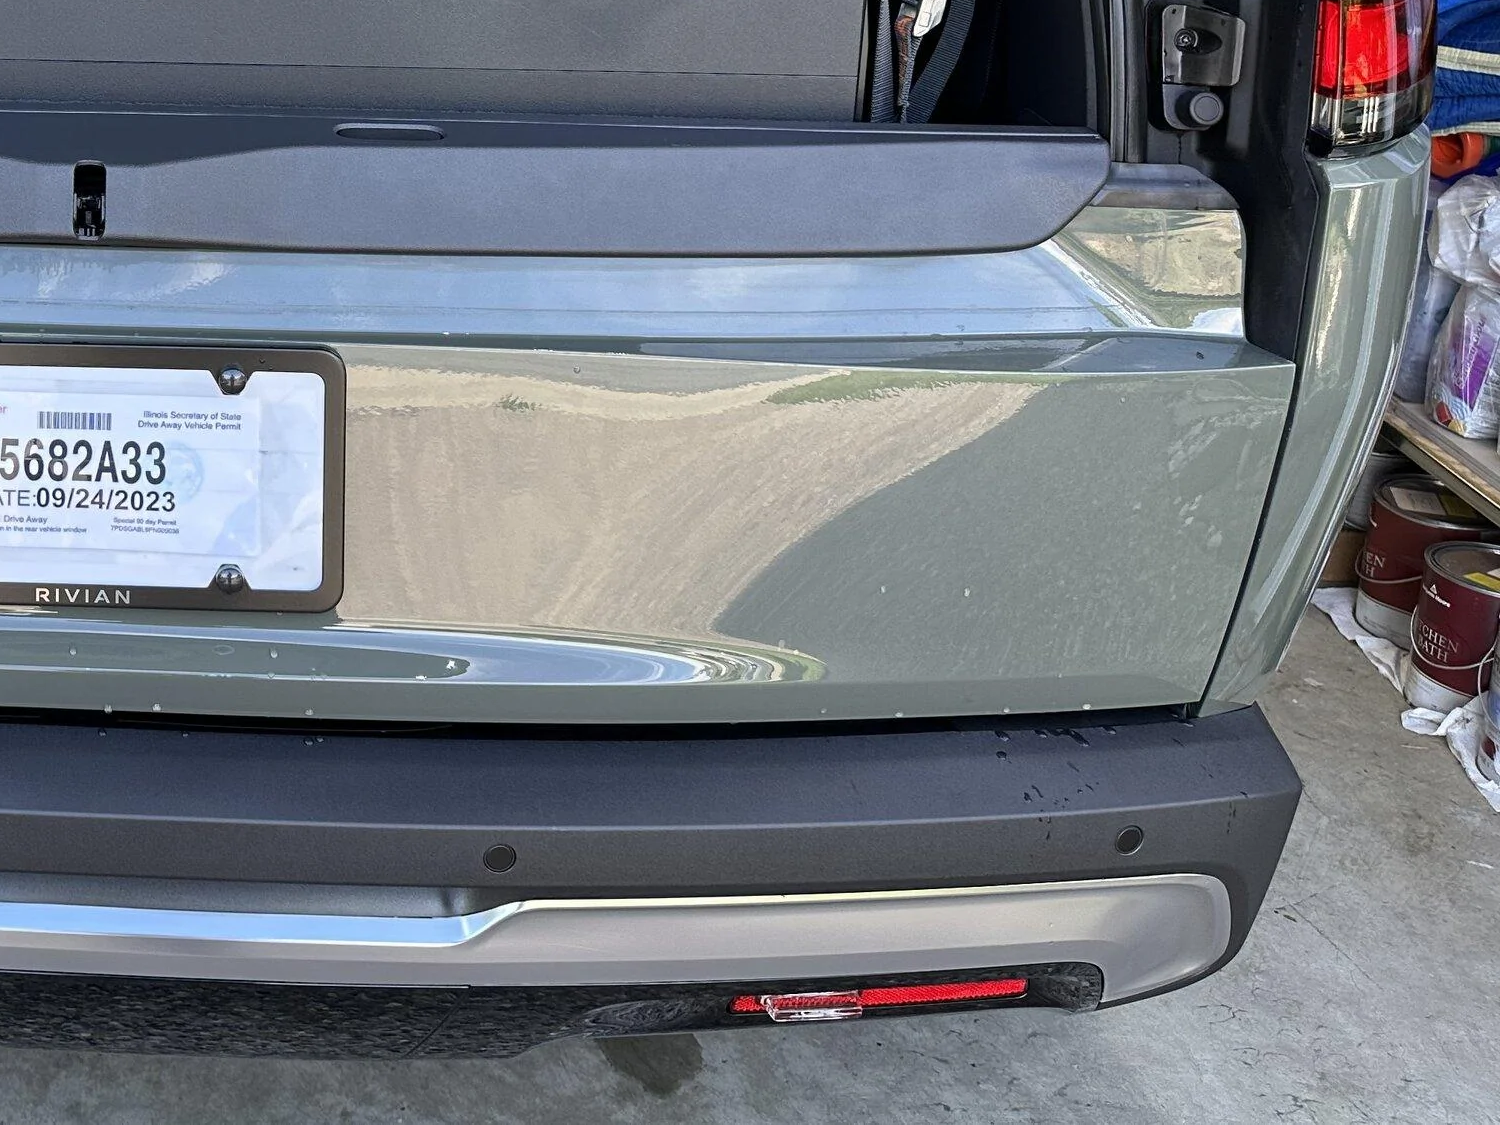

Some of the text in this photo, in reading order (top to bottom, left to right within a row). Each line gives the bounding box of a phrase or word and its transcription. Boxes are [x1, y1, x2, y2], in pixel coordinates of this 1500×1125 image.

[143, 410, 242, 421] Illinois Secretary of State
[137, 420, 242, 431] Drive Away Vehicle Permit
[3, 514, 25, 524] Drive
[26, 515, 49, 526] Away
[39, 526, 63, 534] vehicle
[35, 587, 132, 605] RIVIAN
[1417, 636, 1450, 664] BATH
